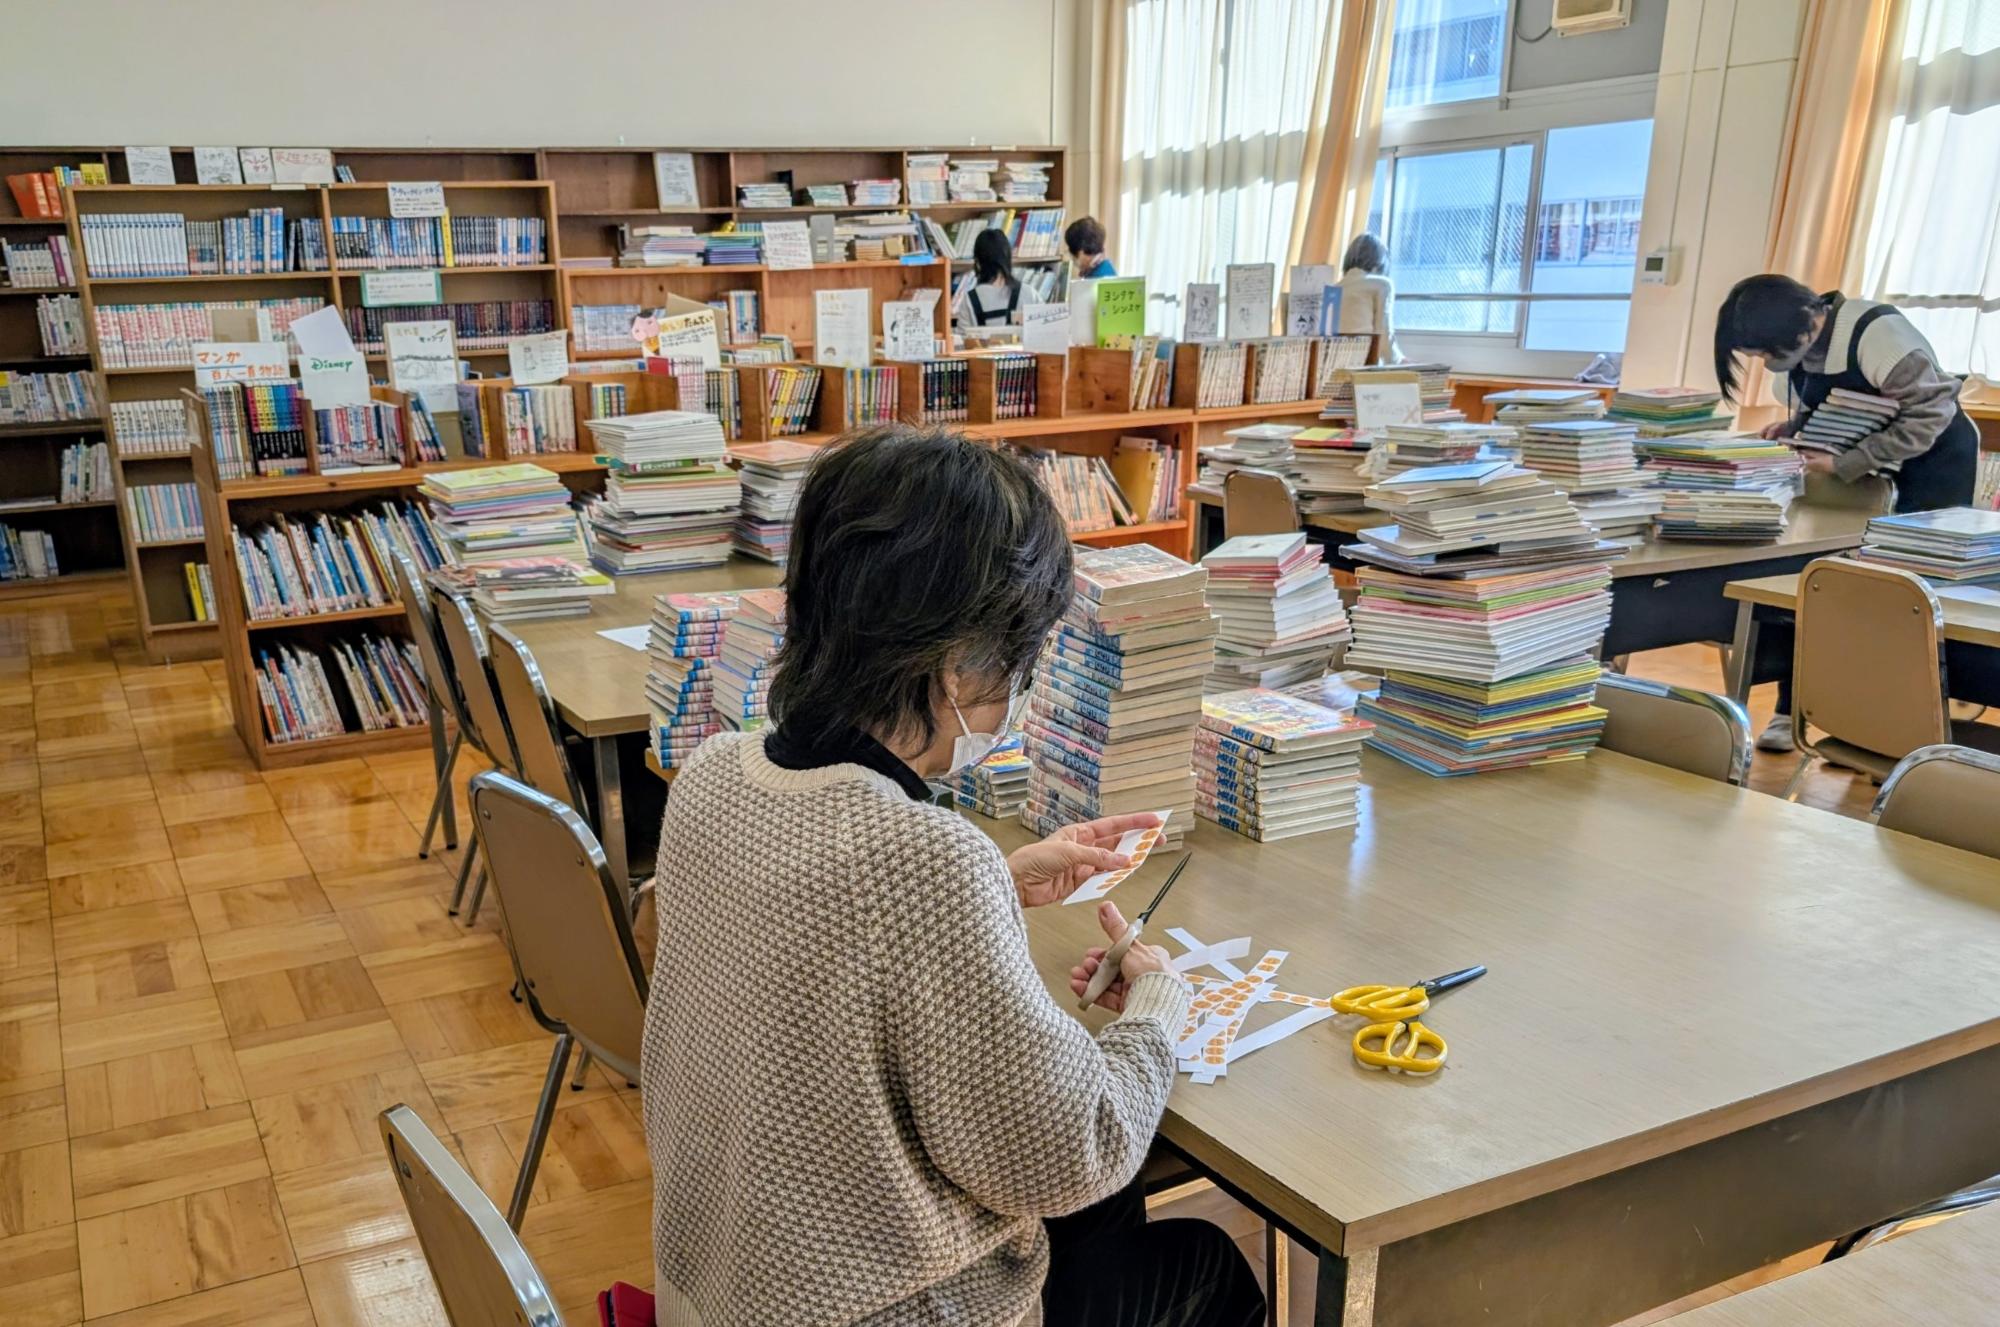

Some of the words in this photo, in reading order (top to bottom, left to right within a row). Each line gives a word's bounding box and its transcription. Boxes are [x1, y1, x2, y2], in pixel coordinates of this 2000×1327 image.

[1104, 291, 1135, 301] ヨシタケ
[1113, 304, 1141, 315] シンスケ
[196, 351, 241, 365] マンガ
[310, 357, 353, 373] Disney
